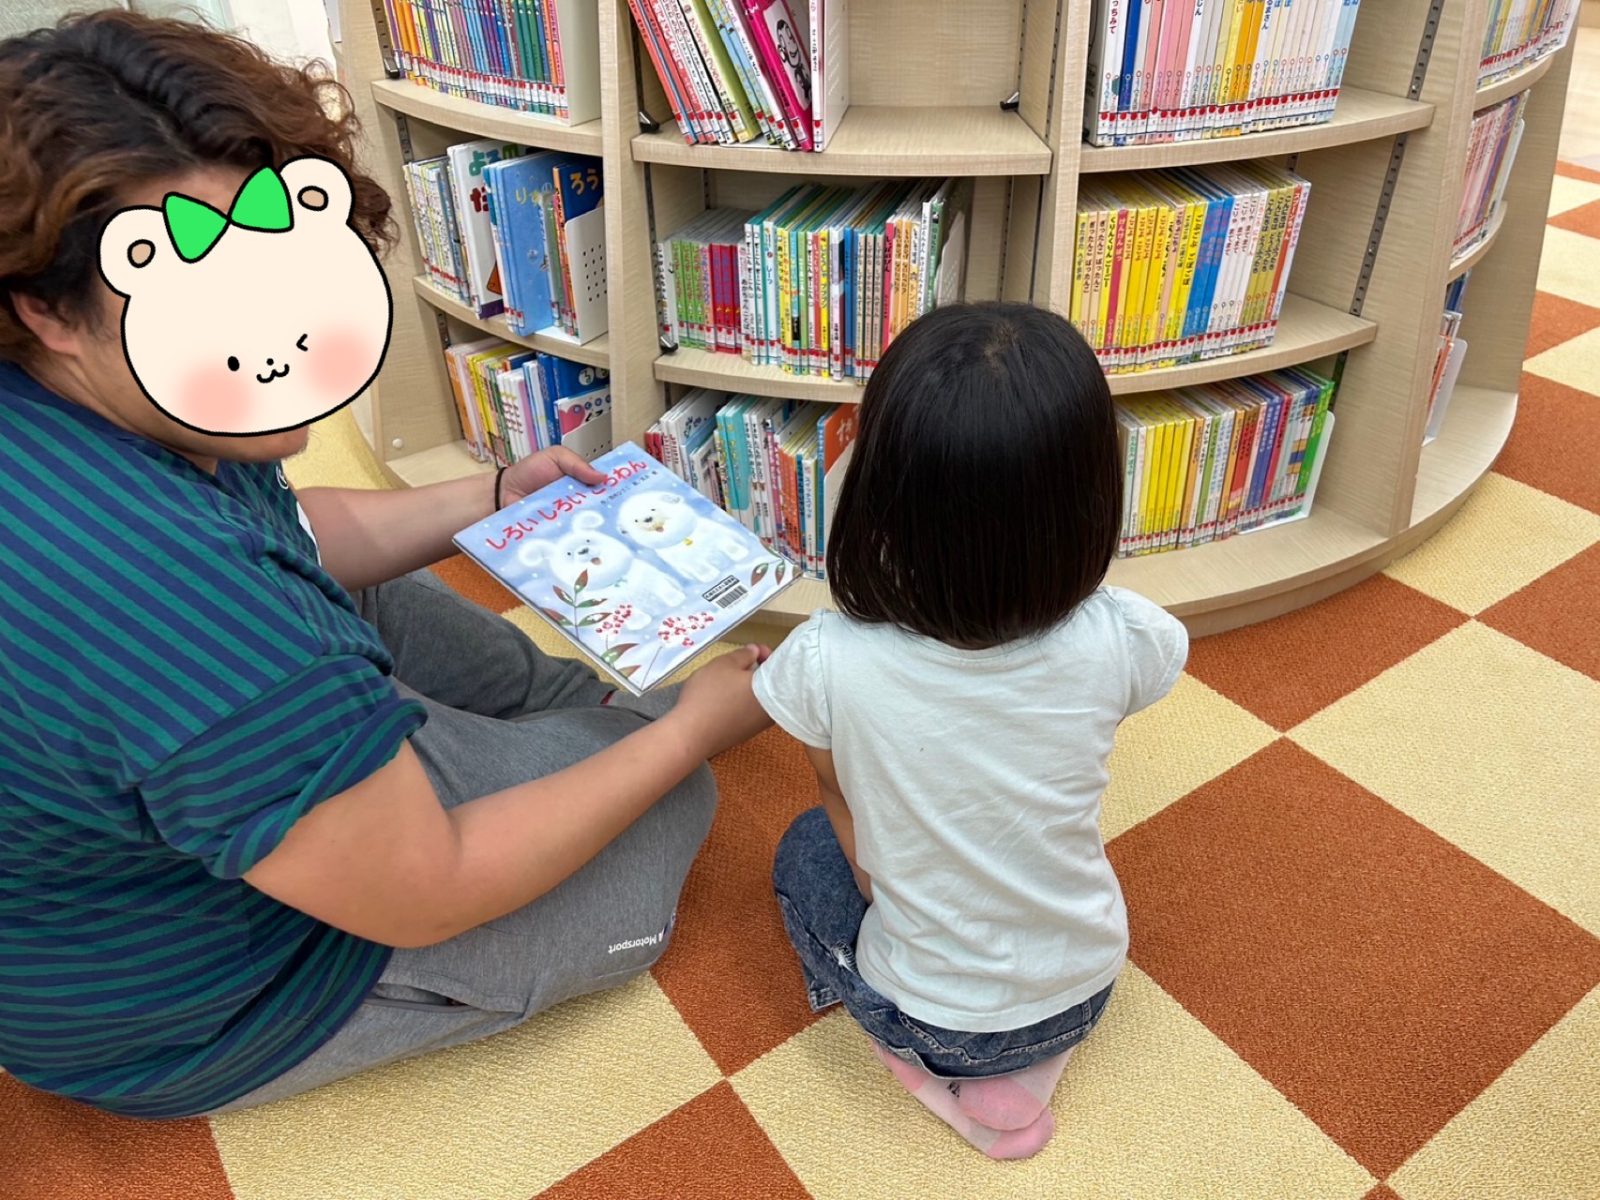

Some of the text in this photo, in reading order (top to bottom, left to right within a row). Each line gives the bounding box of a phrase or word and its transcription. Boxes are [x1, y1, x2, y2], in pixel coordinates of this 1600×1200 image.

[486, 518, 538, 550] しろい
[538, 492, 586, 520] しろい
[607, 934, 657, 955] Motorsport
